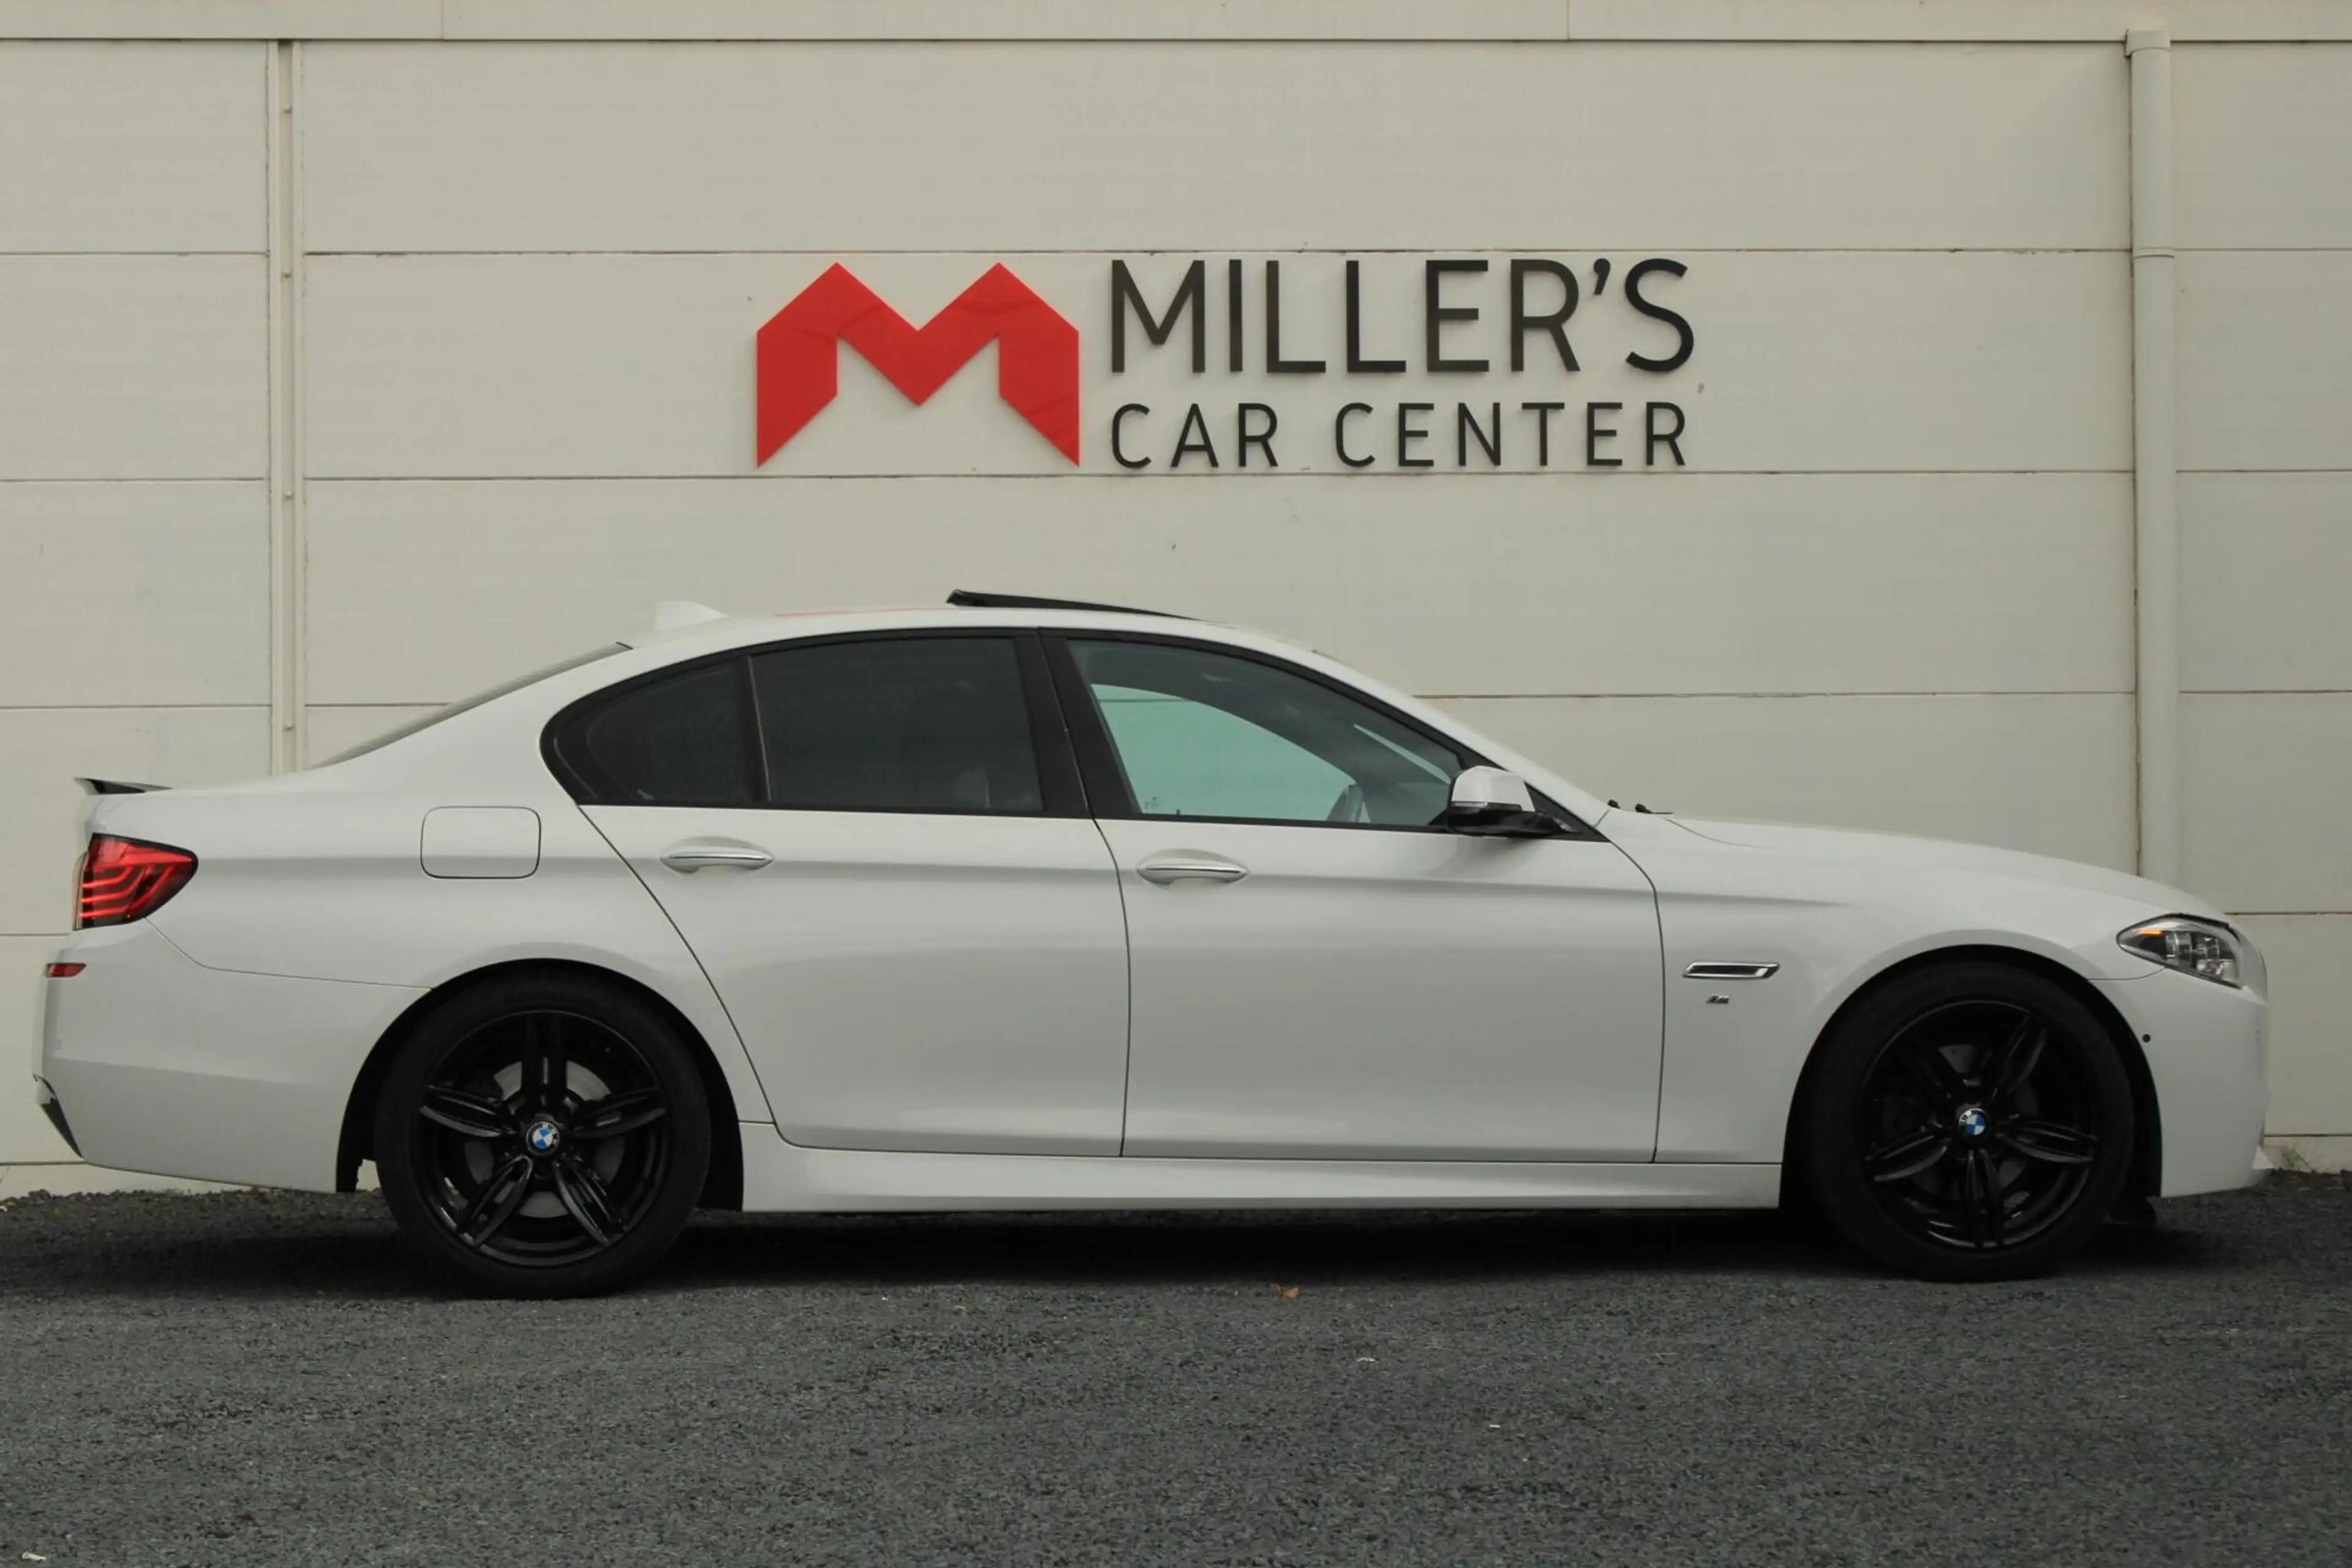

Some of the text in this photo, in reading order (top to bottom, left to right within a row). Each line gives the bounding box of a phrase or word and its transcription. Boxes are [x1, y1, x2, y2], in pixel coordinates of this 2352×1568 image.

[1112, 258, 1695, 374] MILLER'S
[1112, 402, 1685, 469] CAR CENTER
